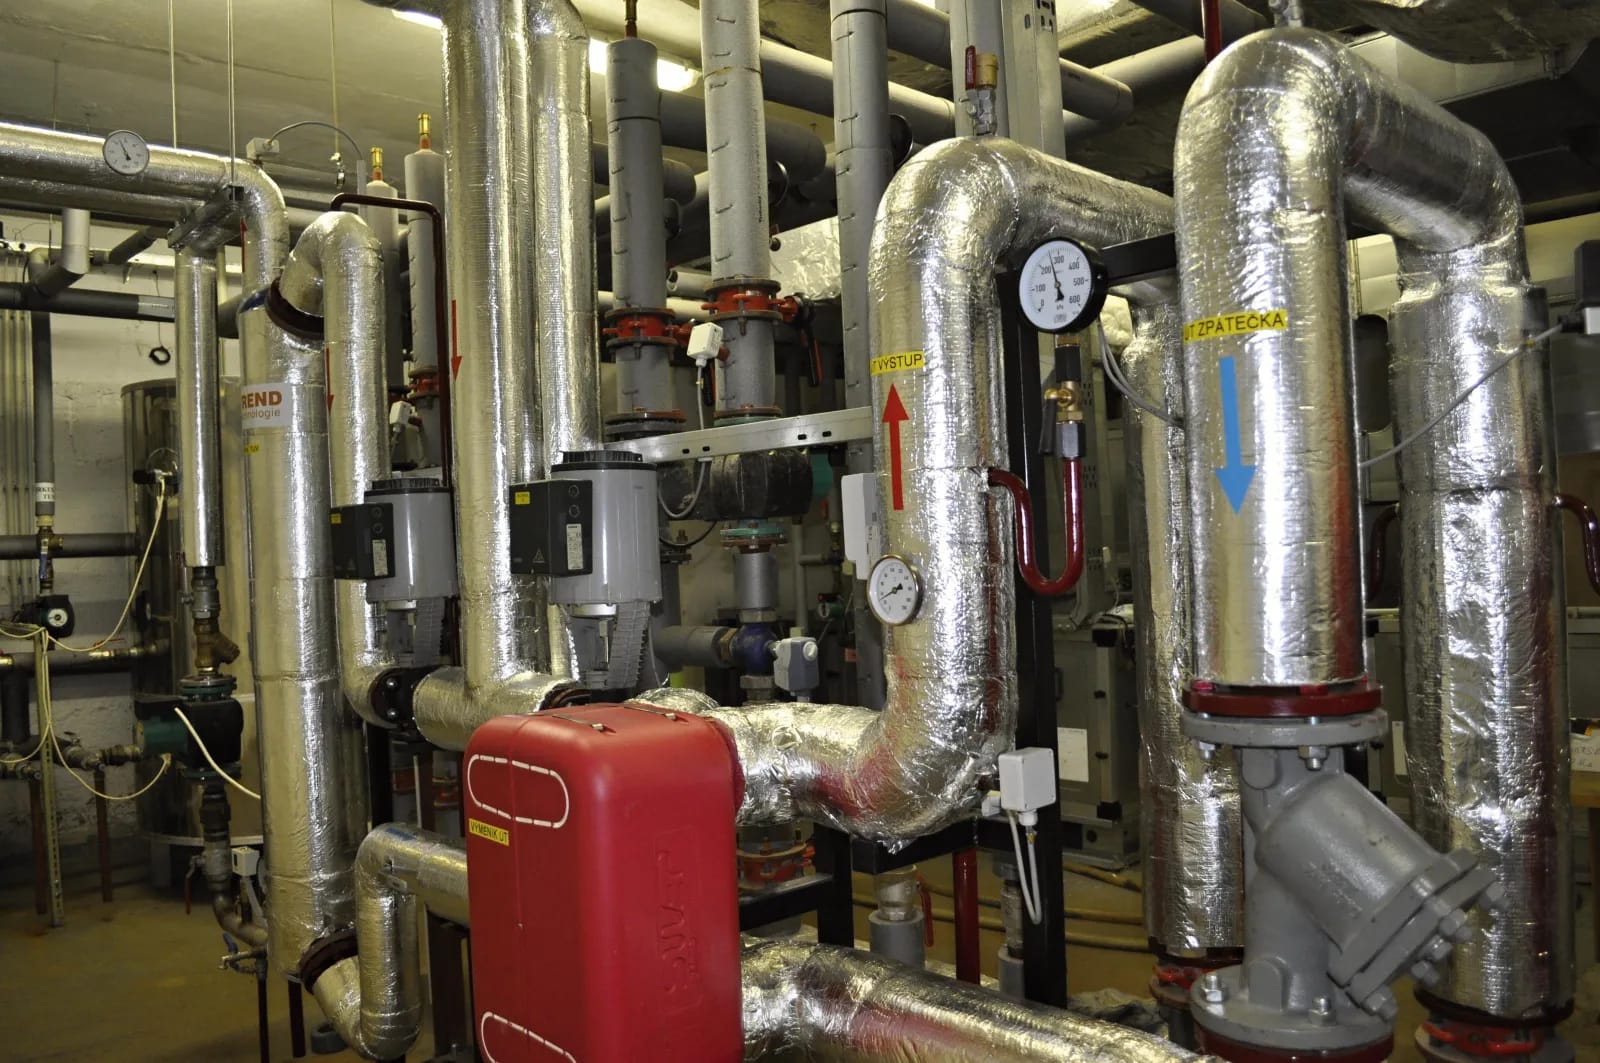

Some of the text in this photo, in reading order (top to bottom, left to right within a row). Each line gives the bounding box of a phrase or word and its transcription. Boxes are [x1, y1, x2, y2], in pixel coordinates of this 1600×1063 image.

[1053, 255, 1064, 264] 300
[1041, 266, 1051, 275] 200
[1074, 277, 1085, 286] 500
